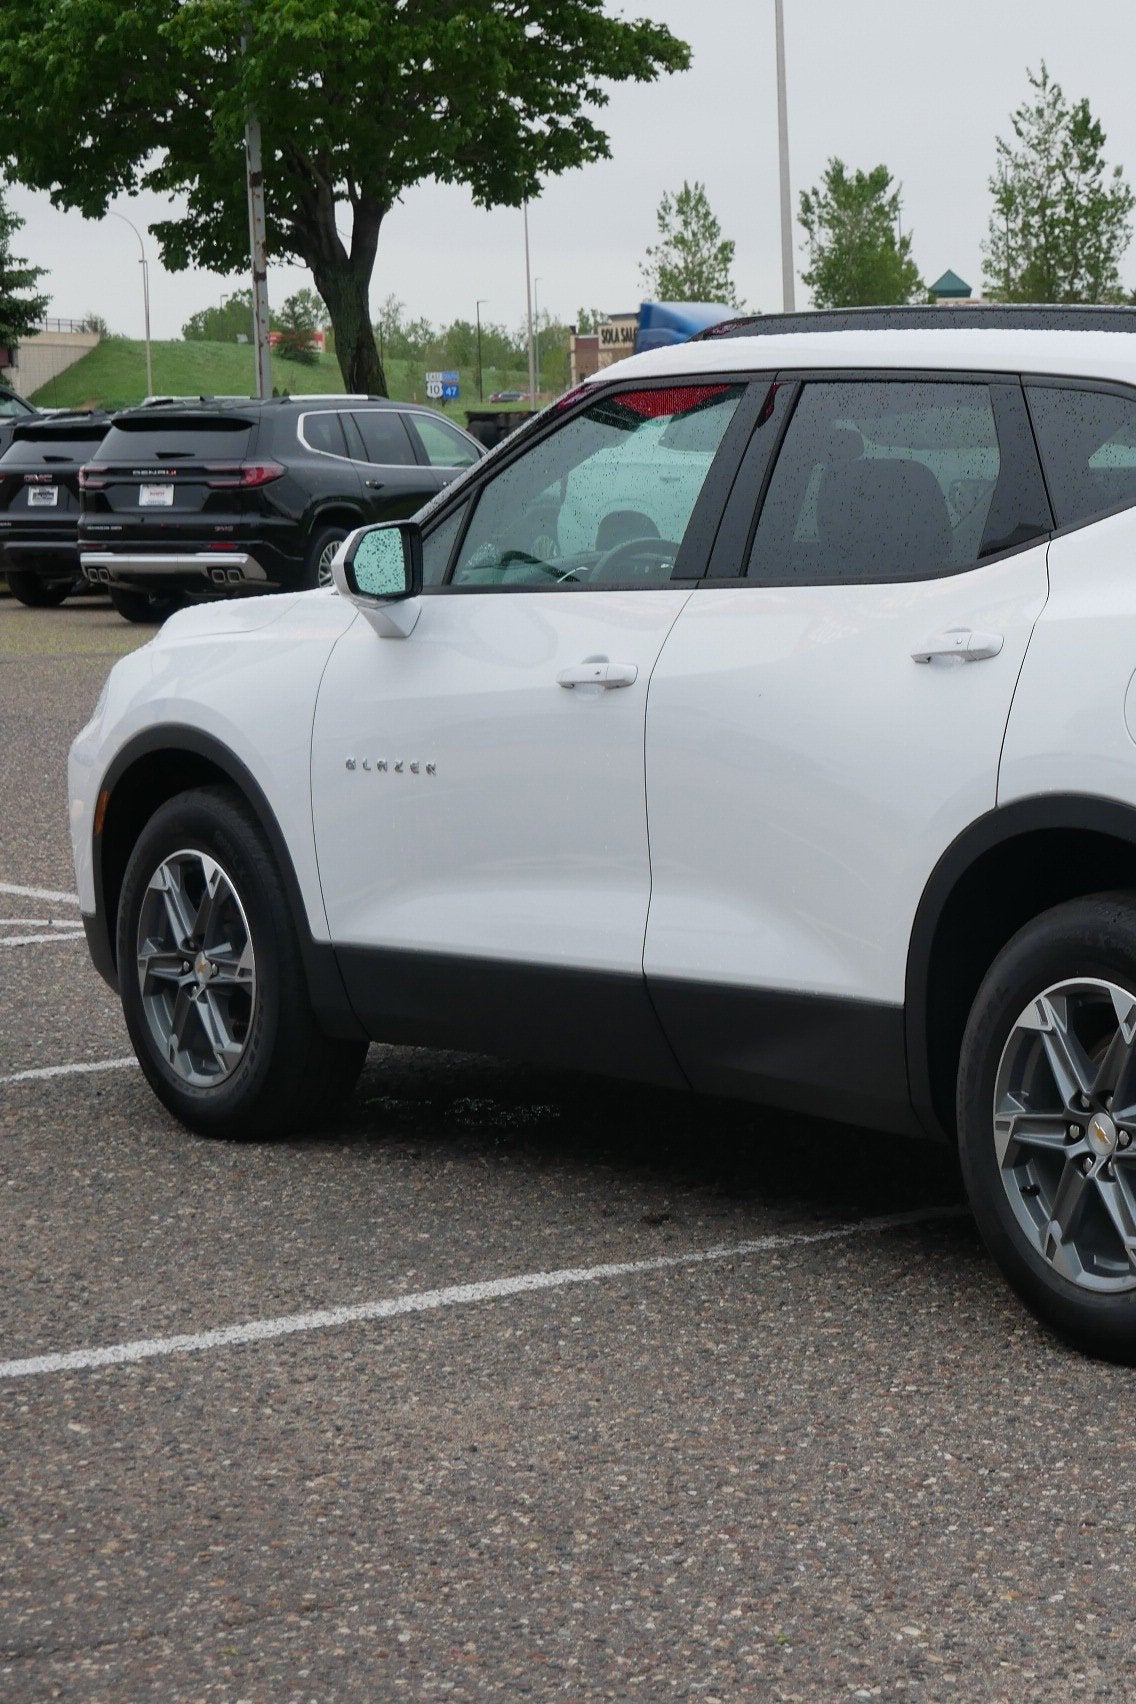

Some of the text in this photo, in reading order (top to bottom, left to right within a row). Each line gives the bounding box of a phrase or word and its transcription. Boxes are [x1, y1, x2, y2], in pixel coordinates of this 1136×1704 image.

[601, 327, 620, 344] SOLA
[430, 385, 440, 395] 10
[445, 386, 457, 396] 47
[345, 758, 437, 776] BLAZER
